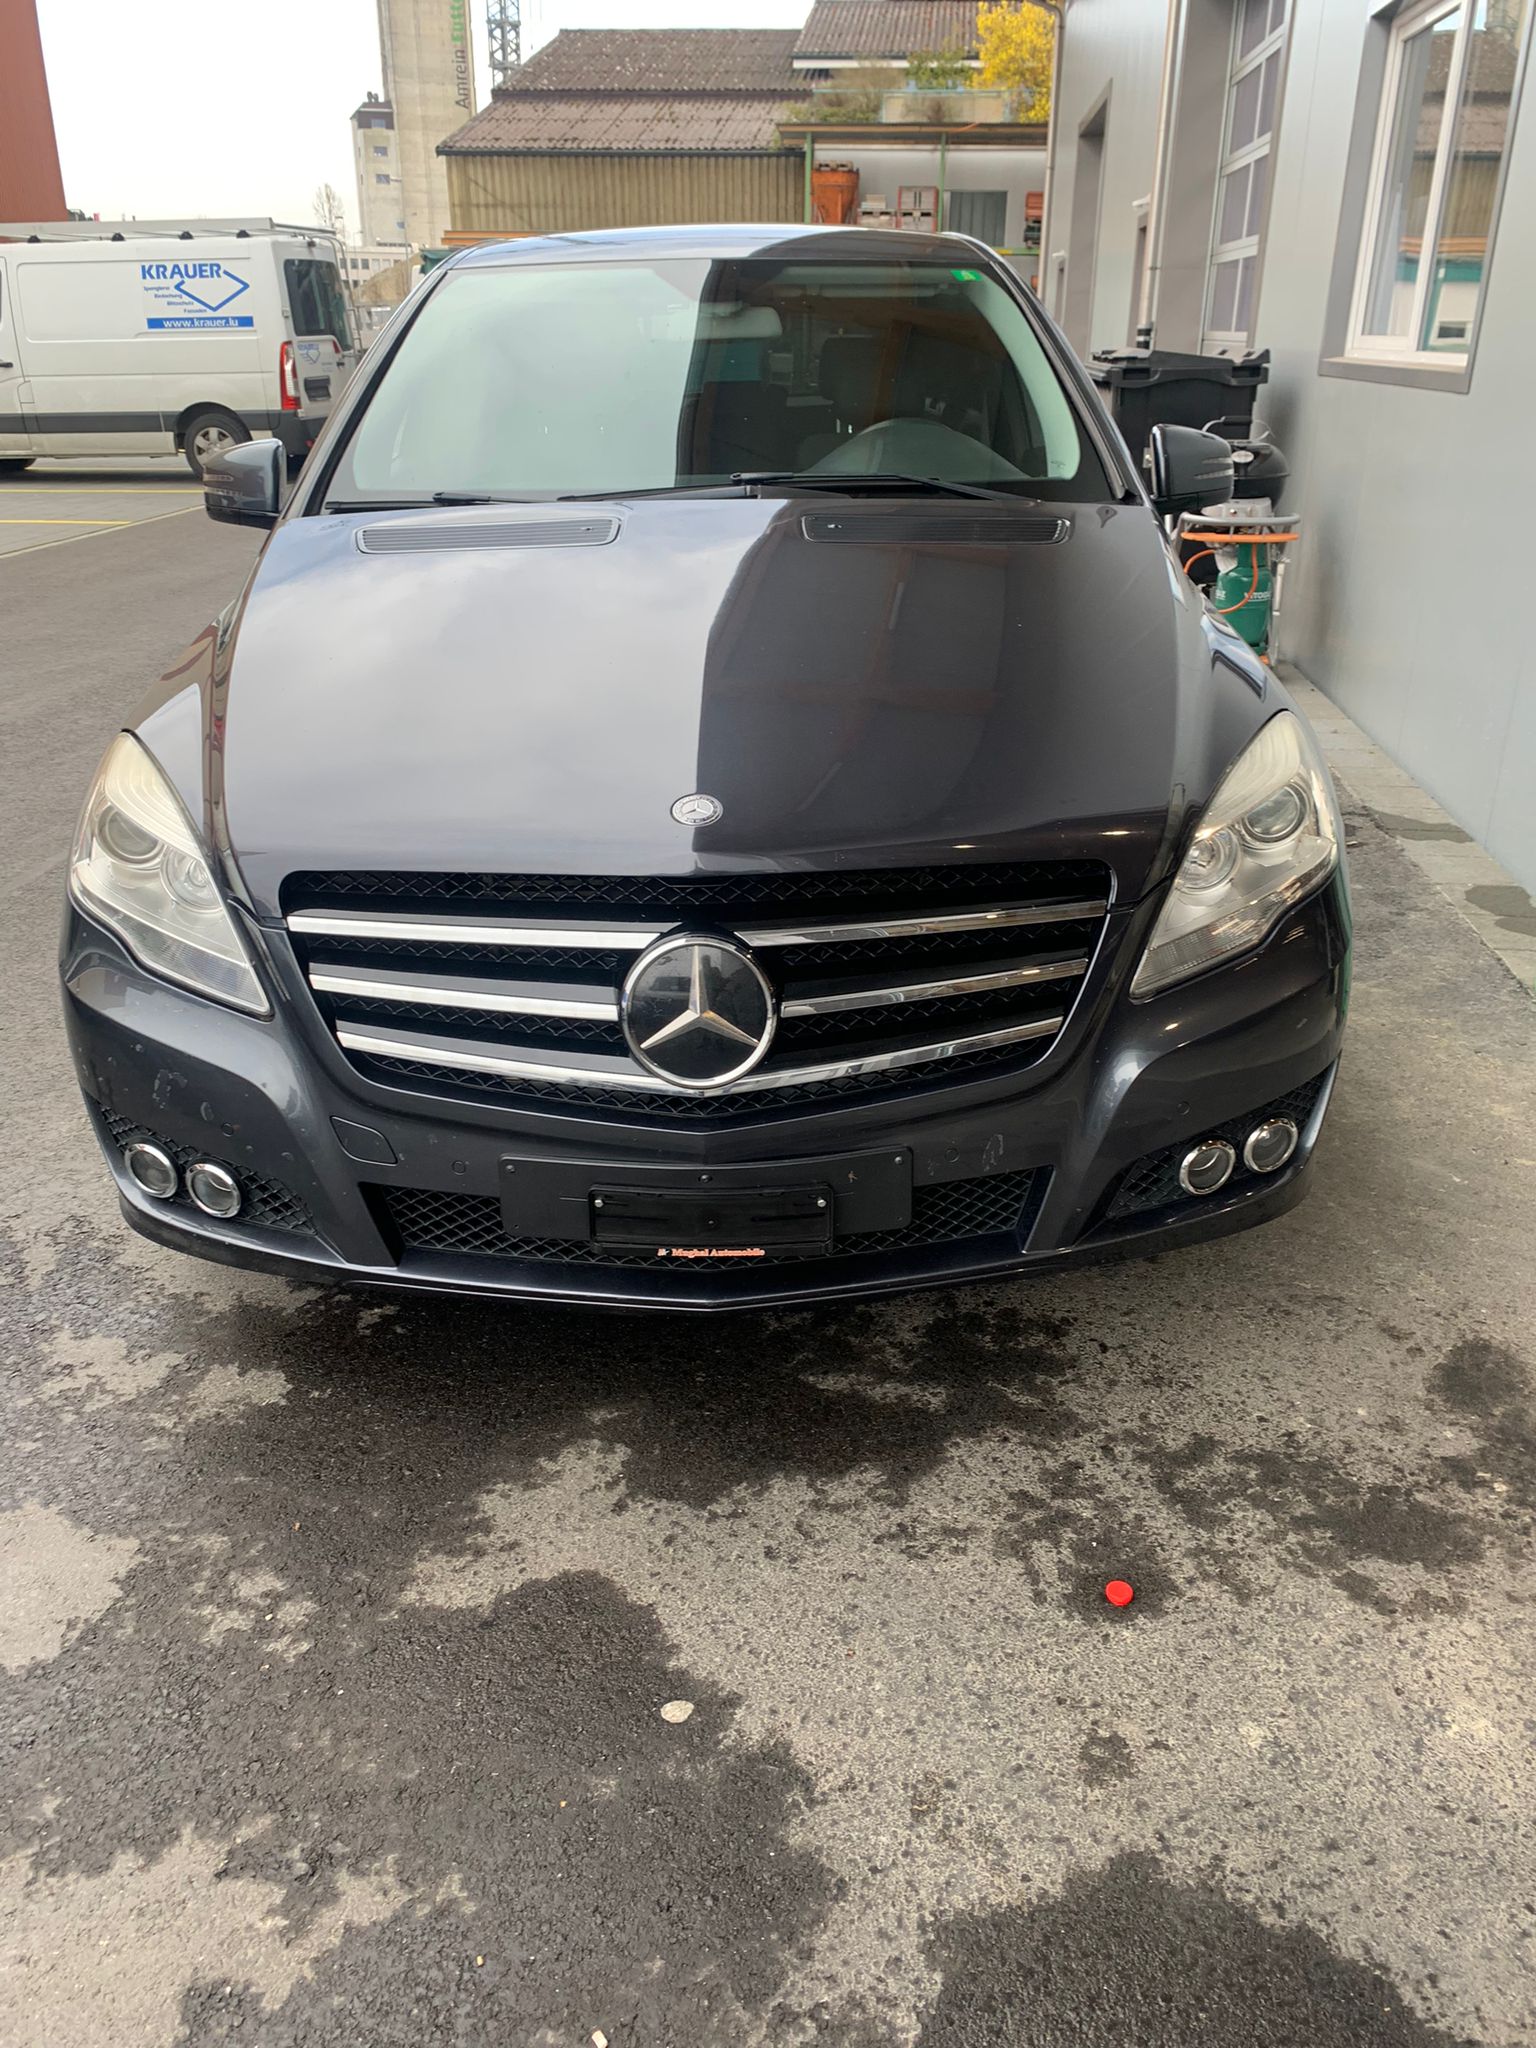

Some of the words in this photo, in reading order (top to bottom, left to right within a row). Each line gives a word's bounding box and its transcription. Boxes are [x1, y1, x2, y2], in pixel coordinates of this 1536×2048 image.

[451, 49, 469, 109] Amrein
[141, 263, 222, 279] KRAUER
[162, 317, 238, 328] www.krauer.lu
[709, 1247, 765, 1257] Automobile
